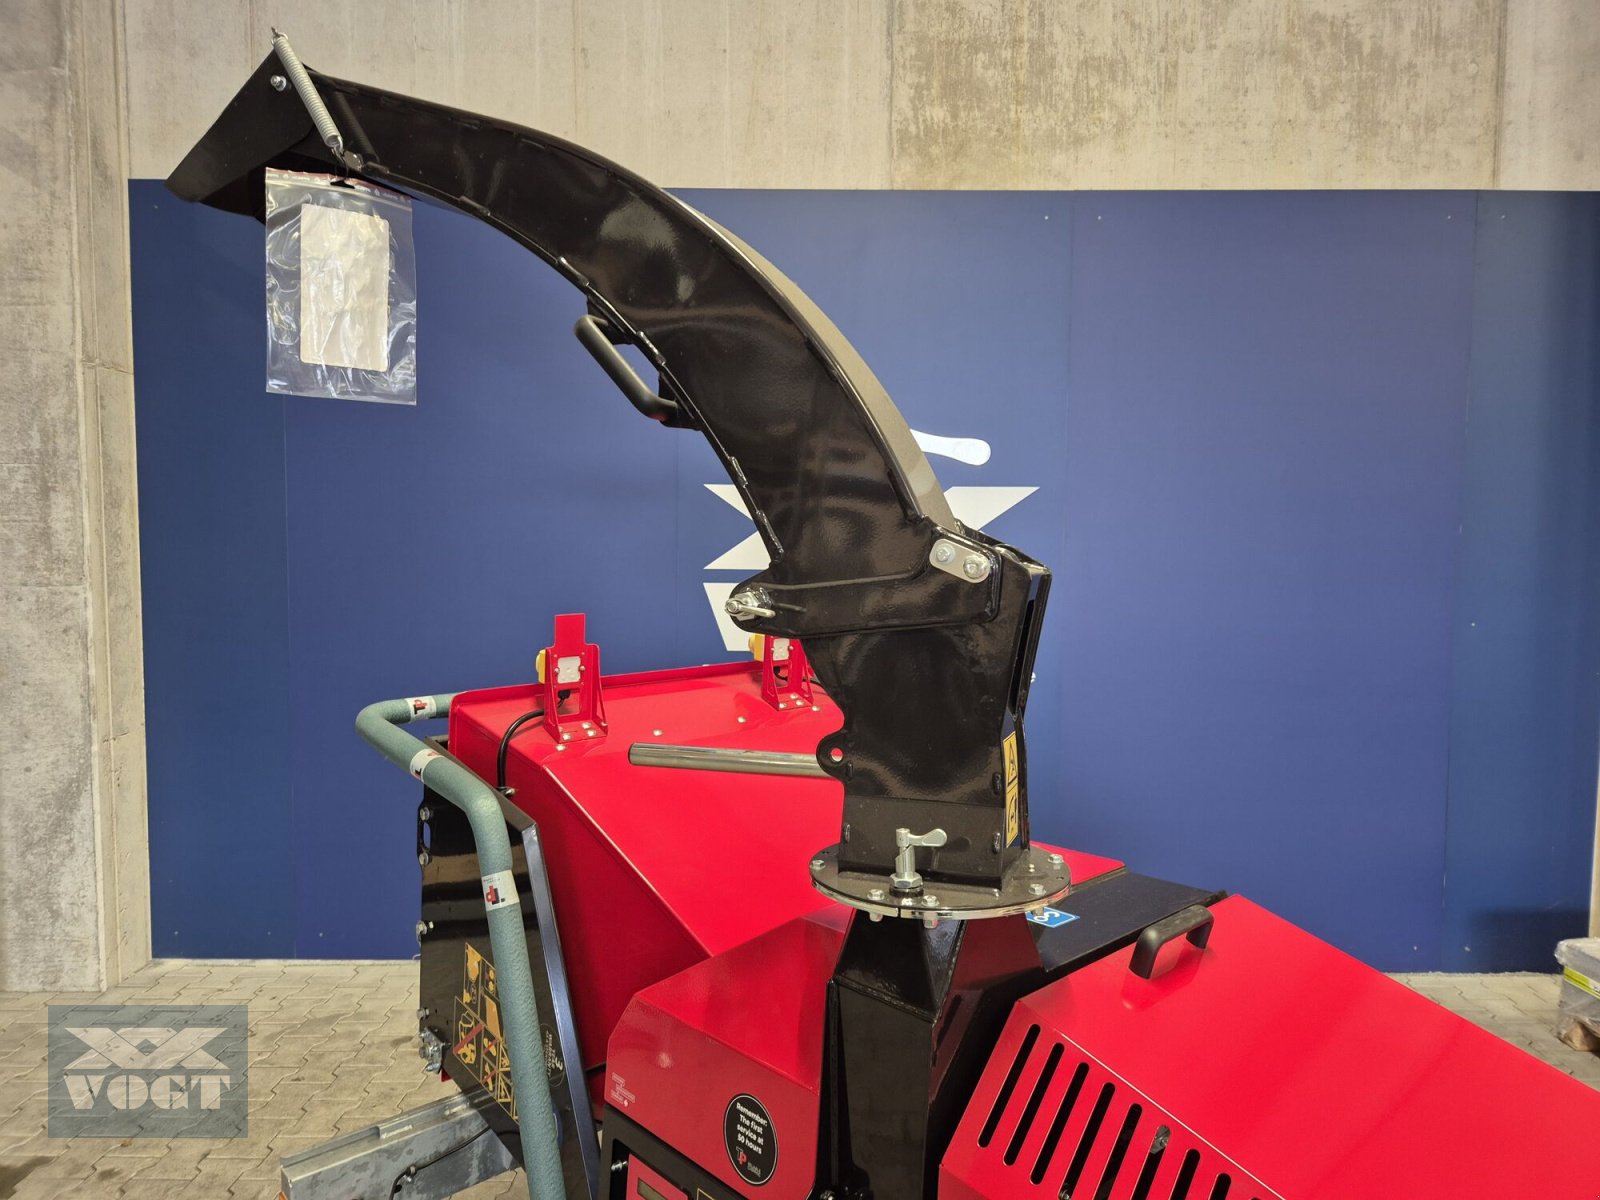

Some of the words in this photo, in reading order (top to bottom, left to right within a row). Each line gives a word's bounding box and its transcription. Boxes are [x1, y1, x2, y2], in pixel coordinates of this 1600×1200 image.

[740, 1114, 750, 1126] The
[751, 1120, 763, 1134] first
[737, 1124, 757, 1141] service
[758, 1136, 764, 1146] at
[737, 1133, 744, 1143] 50
[746, 1138, 762, 1154] hours
